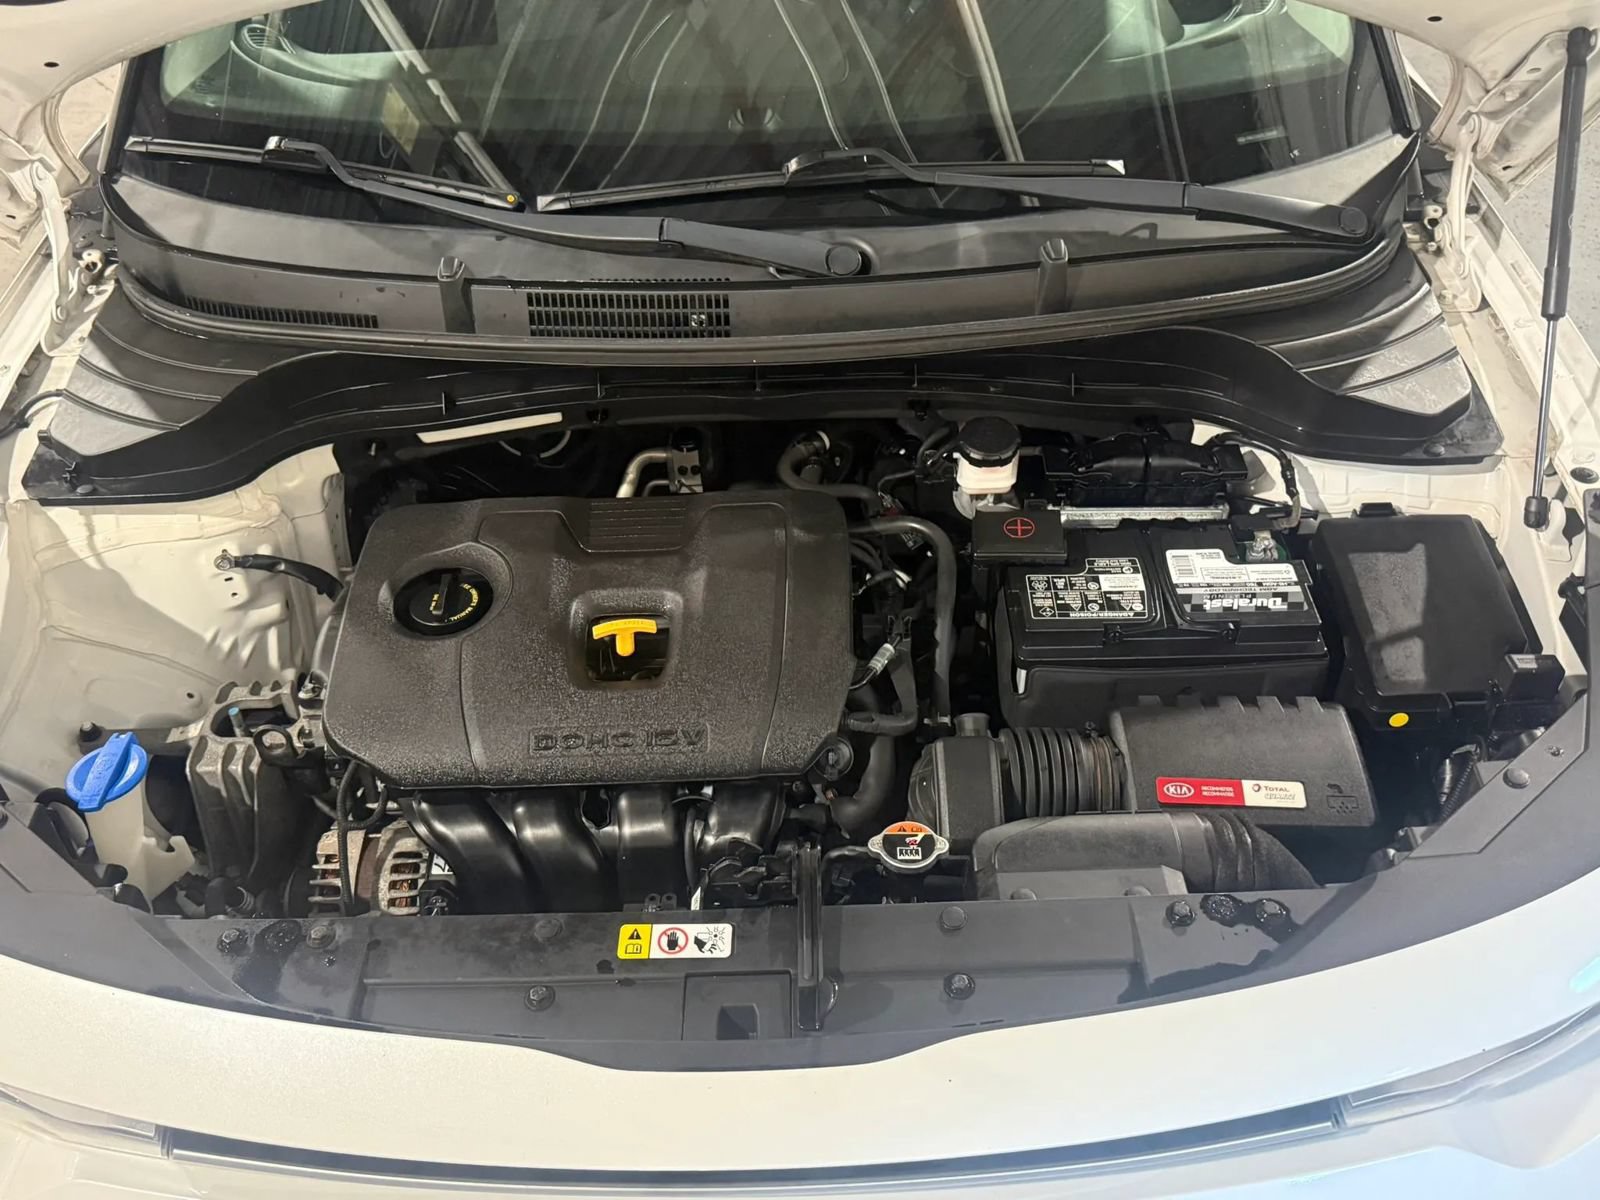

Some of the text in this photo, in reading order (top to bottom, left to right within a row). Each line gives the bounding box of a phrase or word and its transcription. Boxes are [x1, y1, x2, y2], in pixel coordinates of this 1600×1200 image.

[1203, 597, 1287, 610] Duralast
[533, 732, 638, 750] DOHC
[1168, 785, 1189, 795] KIA
